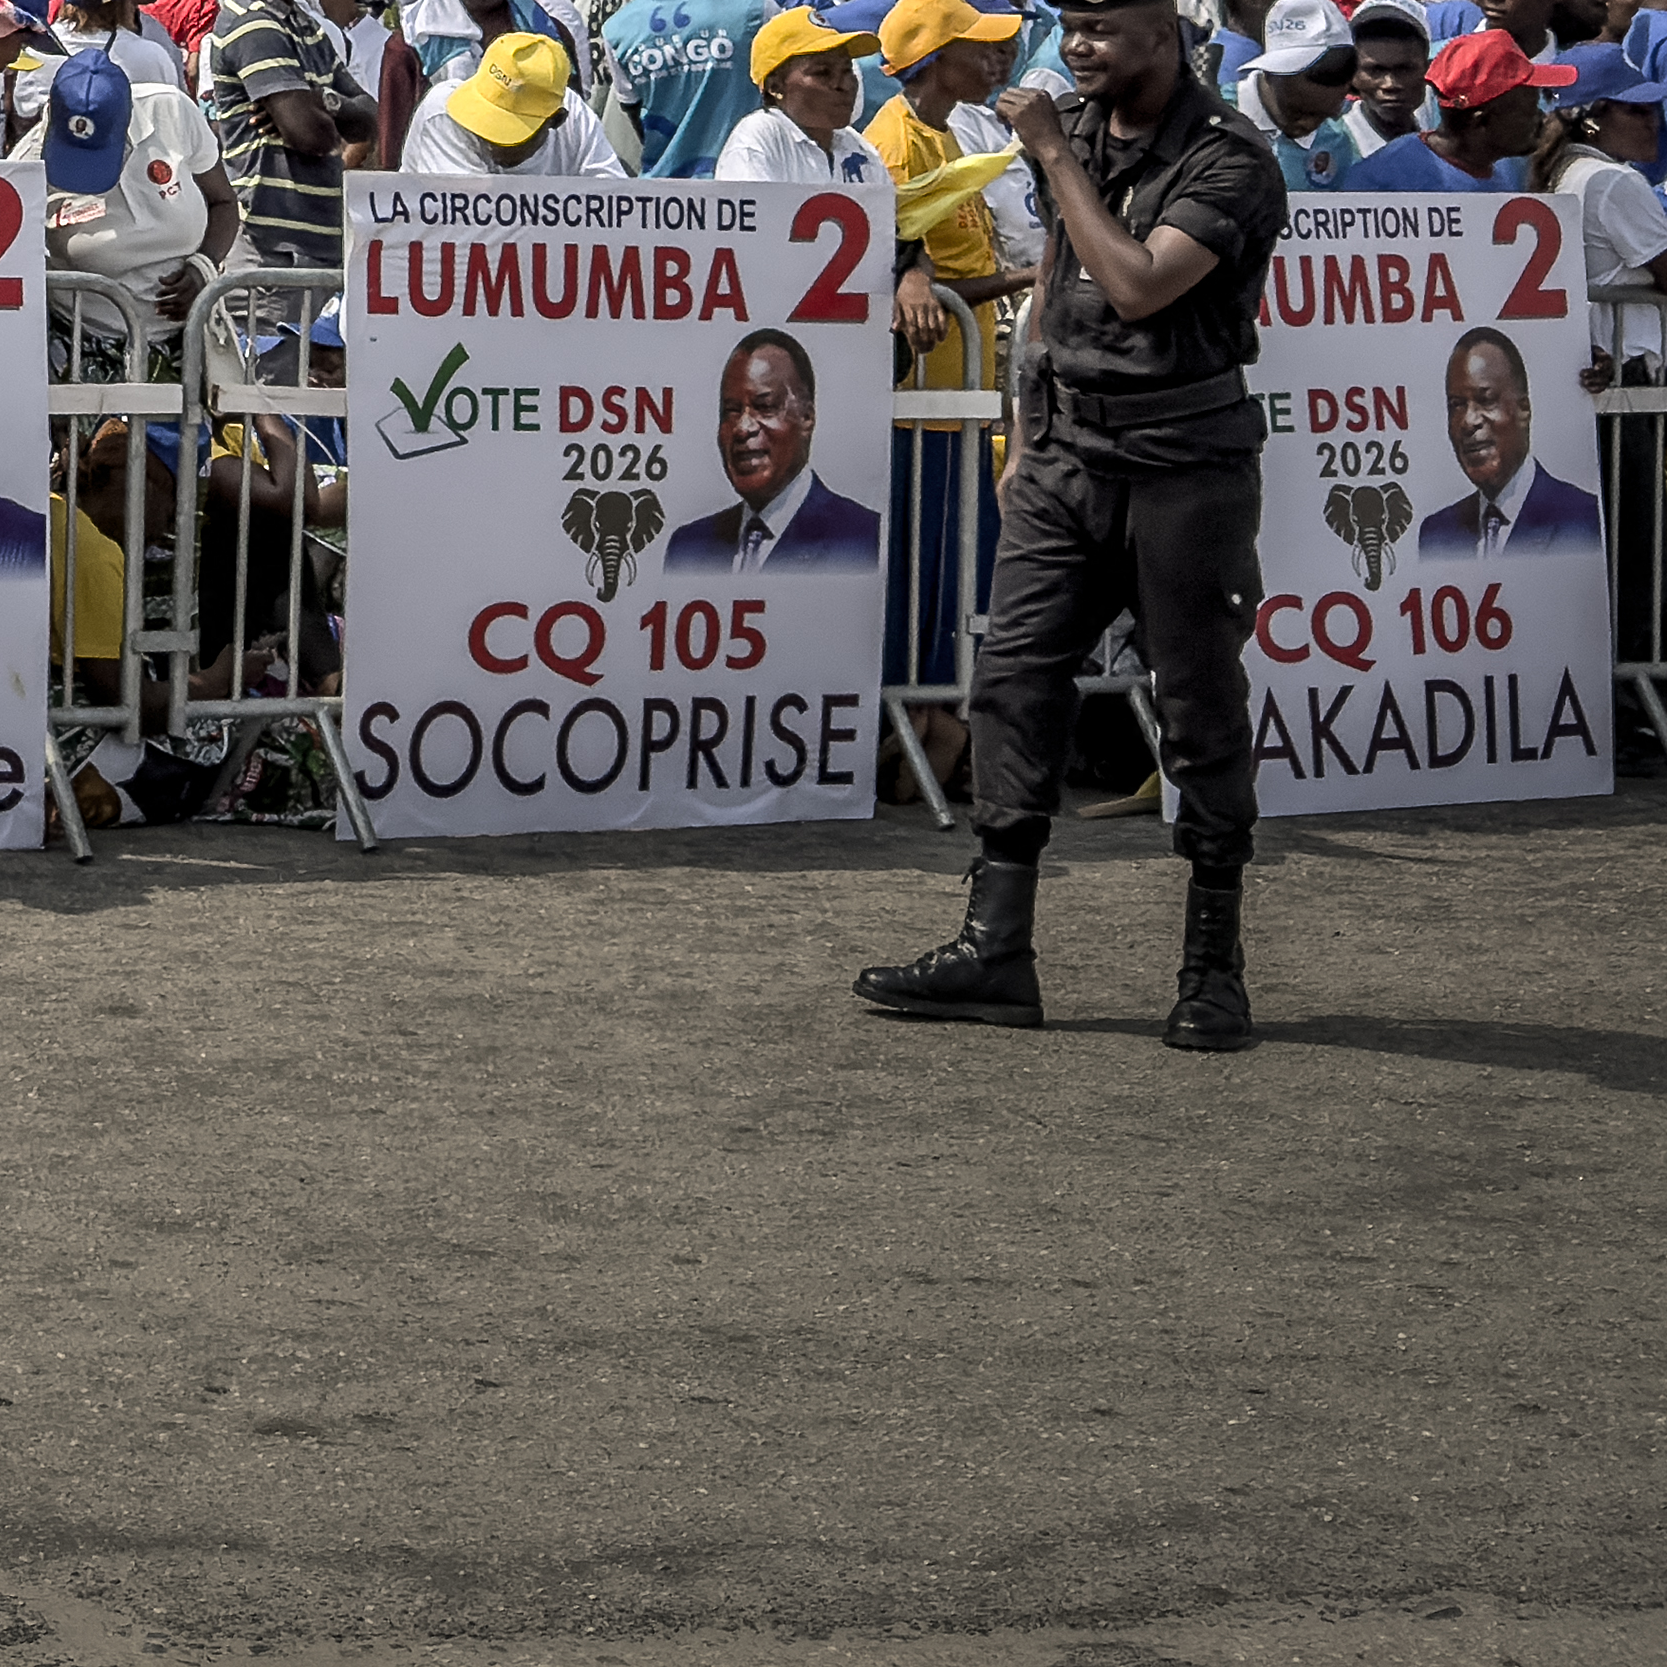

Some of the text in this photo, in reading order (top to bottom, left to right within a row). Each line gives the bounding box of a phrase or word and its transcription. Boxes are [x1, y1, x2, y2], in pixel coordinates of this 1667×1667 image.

[628, 37, 735, 76] CONGO
[158, 181, 183, 201] PCT
[369, 190, 757, 232] LA CIRCONSCRIPTION DE
[1279, 206, 1464, 241] CRIPTION DE
[367, 238, 750, 322] LUMUMBA
[786, 192, 870, 324] 2
[1259, 252, 1465, 328] UMBA
[1491, 196, 1568, 322] 2
[389, 341, 674, 435] VOTE DSN
[1307, 385, 1409, 434] DSN
[561, 442, 668, 482] 2026
[1316, 440, 1410, 479] 2026
[468, 598, 767, 687] CQ 105
[1254, 582, 1514, 672] CQ 106
[355, 692, 860, 801] SOCOPRISE
[1252, 665, 1598, 781] AKADILA
